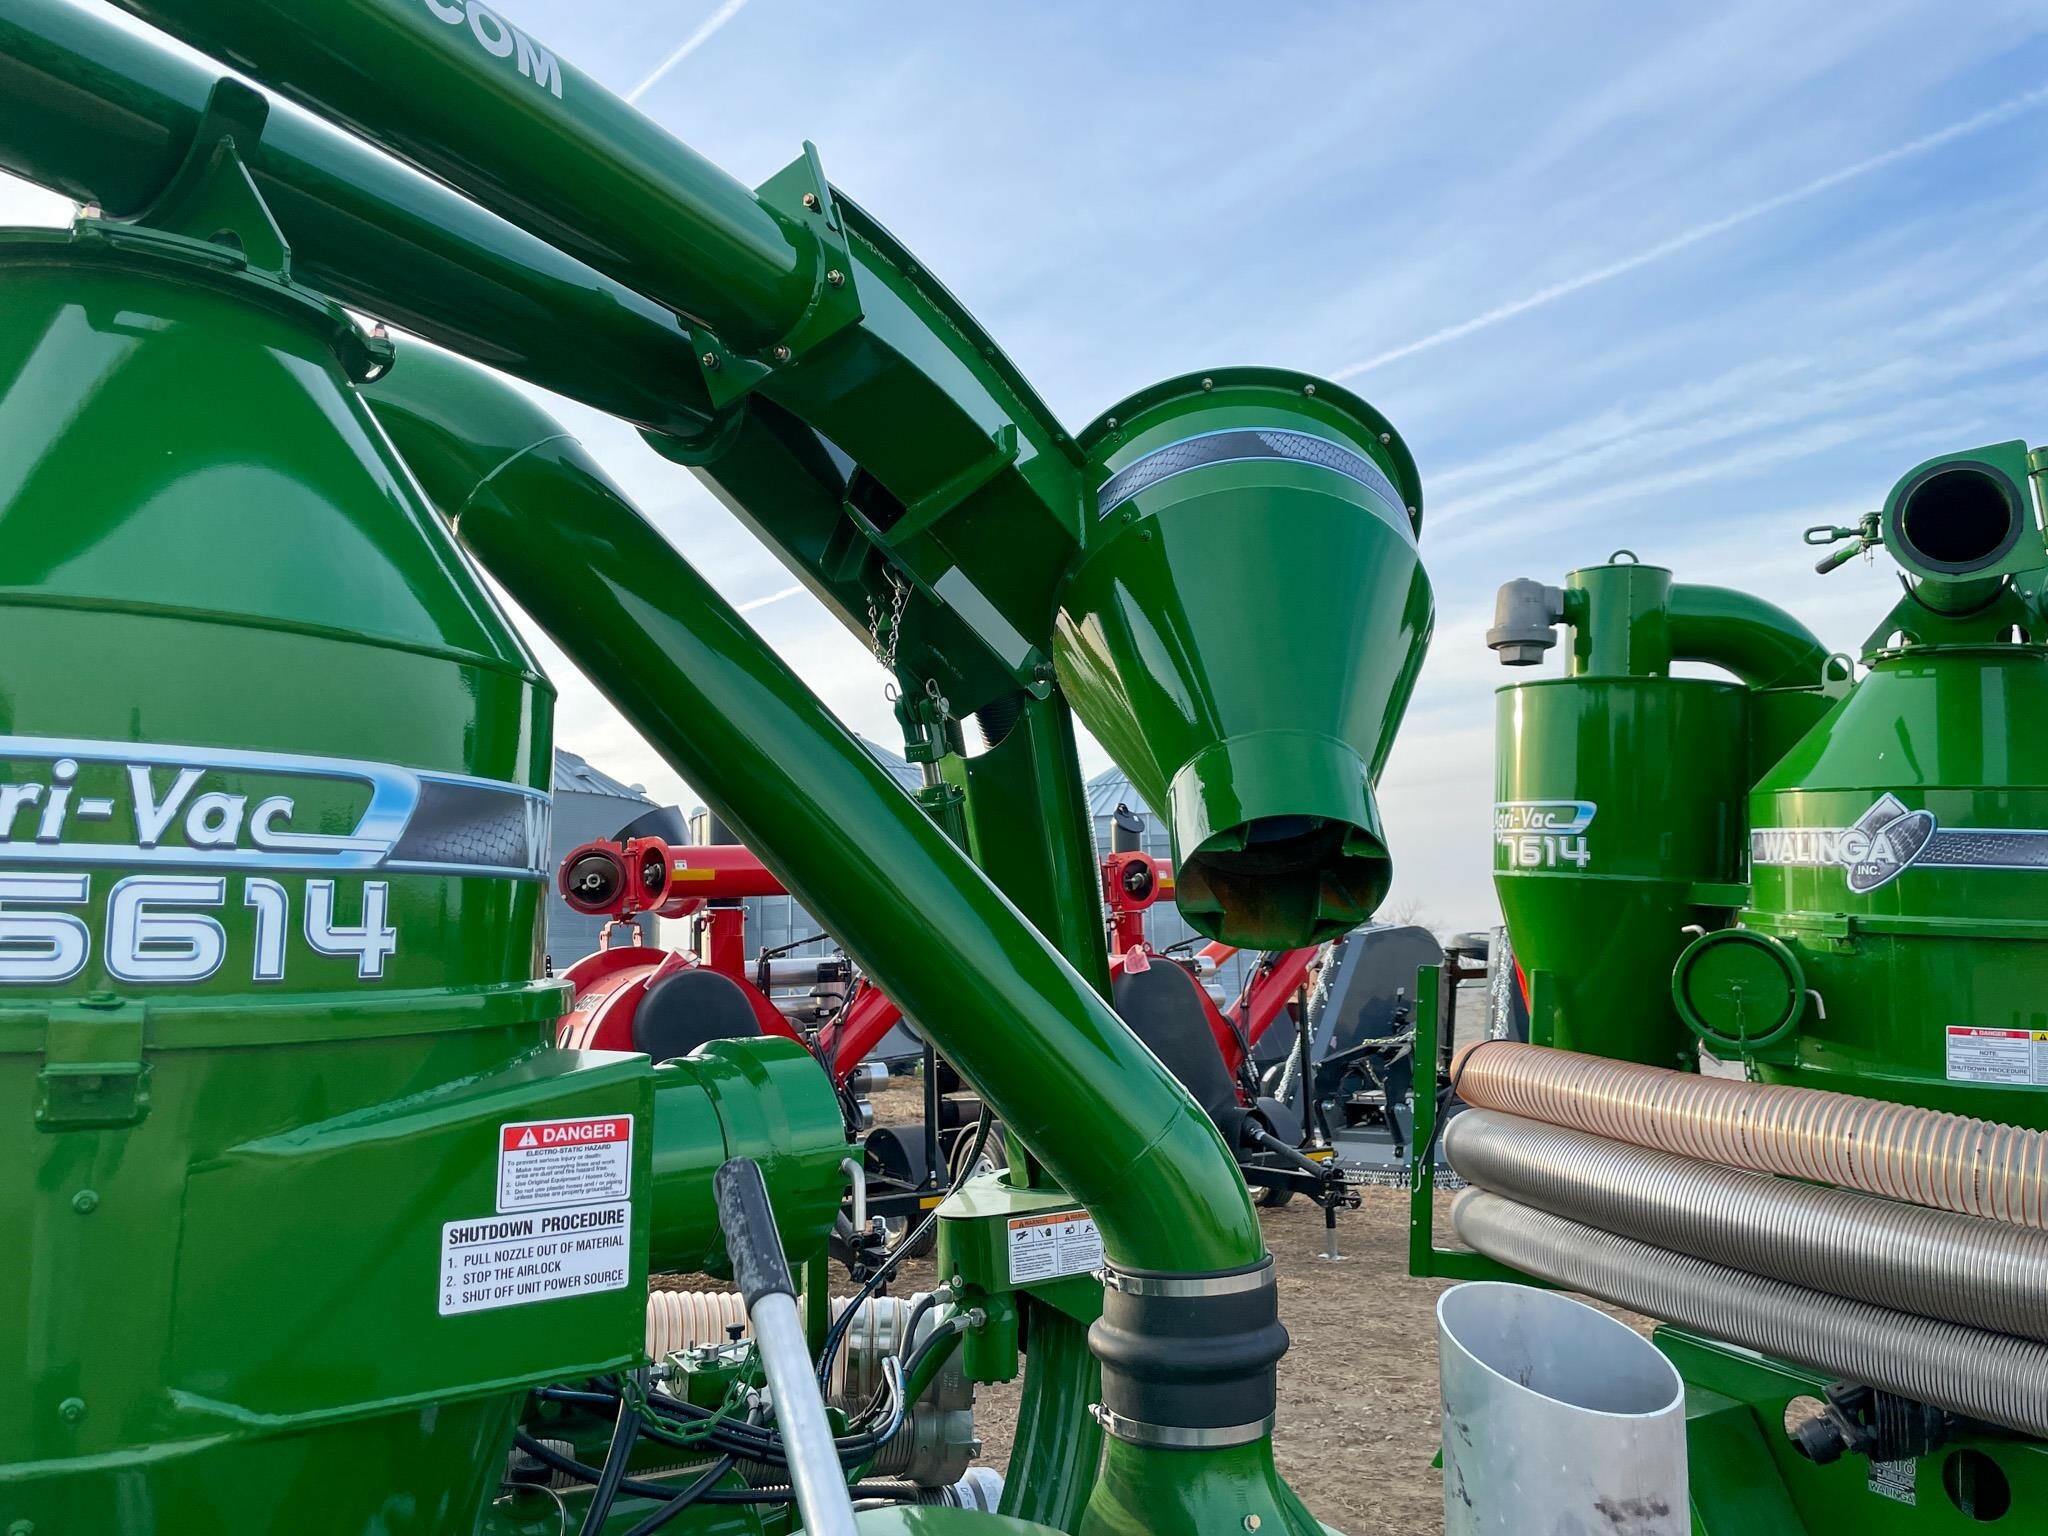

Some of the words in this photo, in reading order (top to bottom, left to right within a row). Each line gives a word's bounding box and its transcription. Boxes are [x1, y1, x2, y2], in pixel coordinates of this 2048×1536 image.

[1502, 836, 1590, 868] 7614
[1762, 829, 1898, 864] WALINGA
[1857, 865, 1880, 876] INC.
[543, 1124, 616, 1142] DANGER
[526, 1148, 582, 1156] ELECTRO-STATIC
[449, 1220, 533, 1245] SHUTDOWN
[541, 1209, 625, 1233] PROCEDURE
[448, 1257, 458, 1269] 1.
[464, 1252, 491, 1266] PULL
[494, 1247, 534, 1263] NOZZLE
[537, 1243, 557, 1257] OUT
[560, 1241, 574, 1253] OF
[576, 1235, 624, 1251] MATERIAL
[446, 1276, 456, 1288] 2.
[464, 1270, 491, 1285] STOP
[494, 1267, 514, 1280] THE
[517, 1261, 561, 1278] AIRLOCK
[446, 1294, 455, 1306] 3.
[462, 1289, 491, 1303] SHUT
[494, 1286, 514, 1299] OFF
[517, 1281, 540, 1296] UNIT
[544, 1275, 581, 1291] POWER
[584, 1269, 624, 1285] SOURCE
[1869, 1480, 1915, 1505] WALINGA
